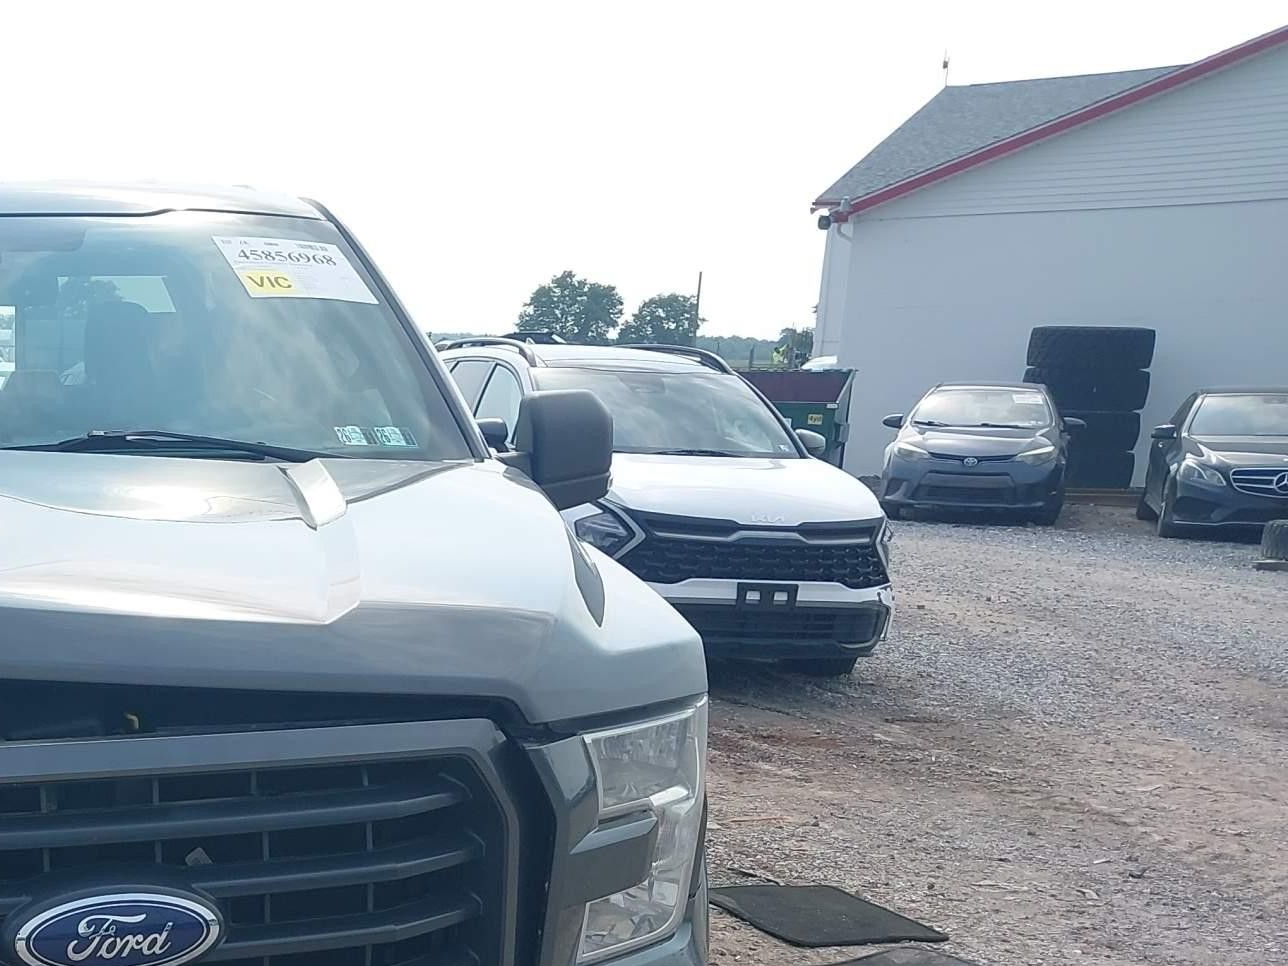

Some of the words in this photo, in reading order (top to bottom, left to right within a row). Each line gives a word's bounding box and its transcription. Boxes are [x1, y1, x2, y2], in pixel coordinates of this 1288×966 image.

[238, 249, 337, 266] 45856968
[247, 276, 293, 289] VIC
[67, 913, 174, 961] Ford
